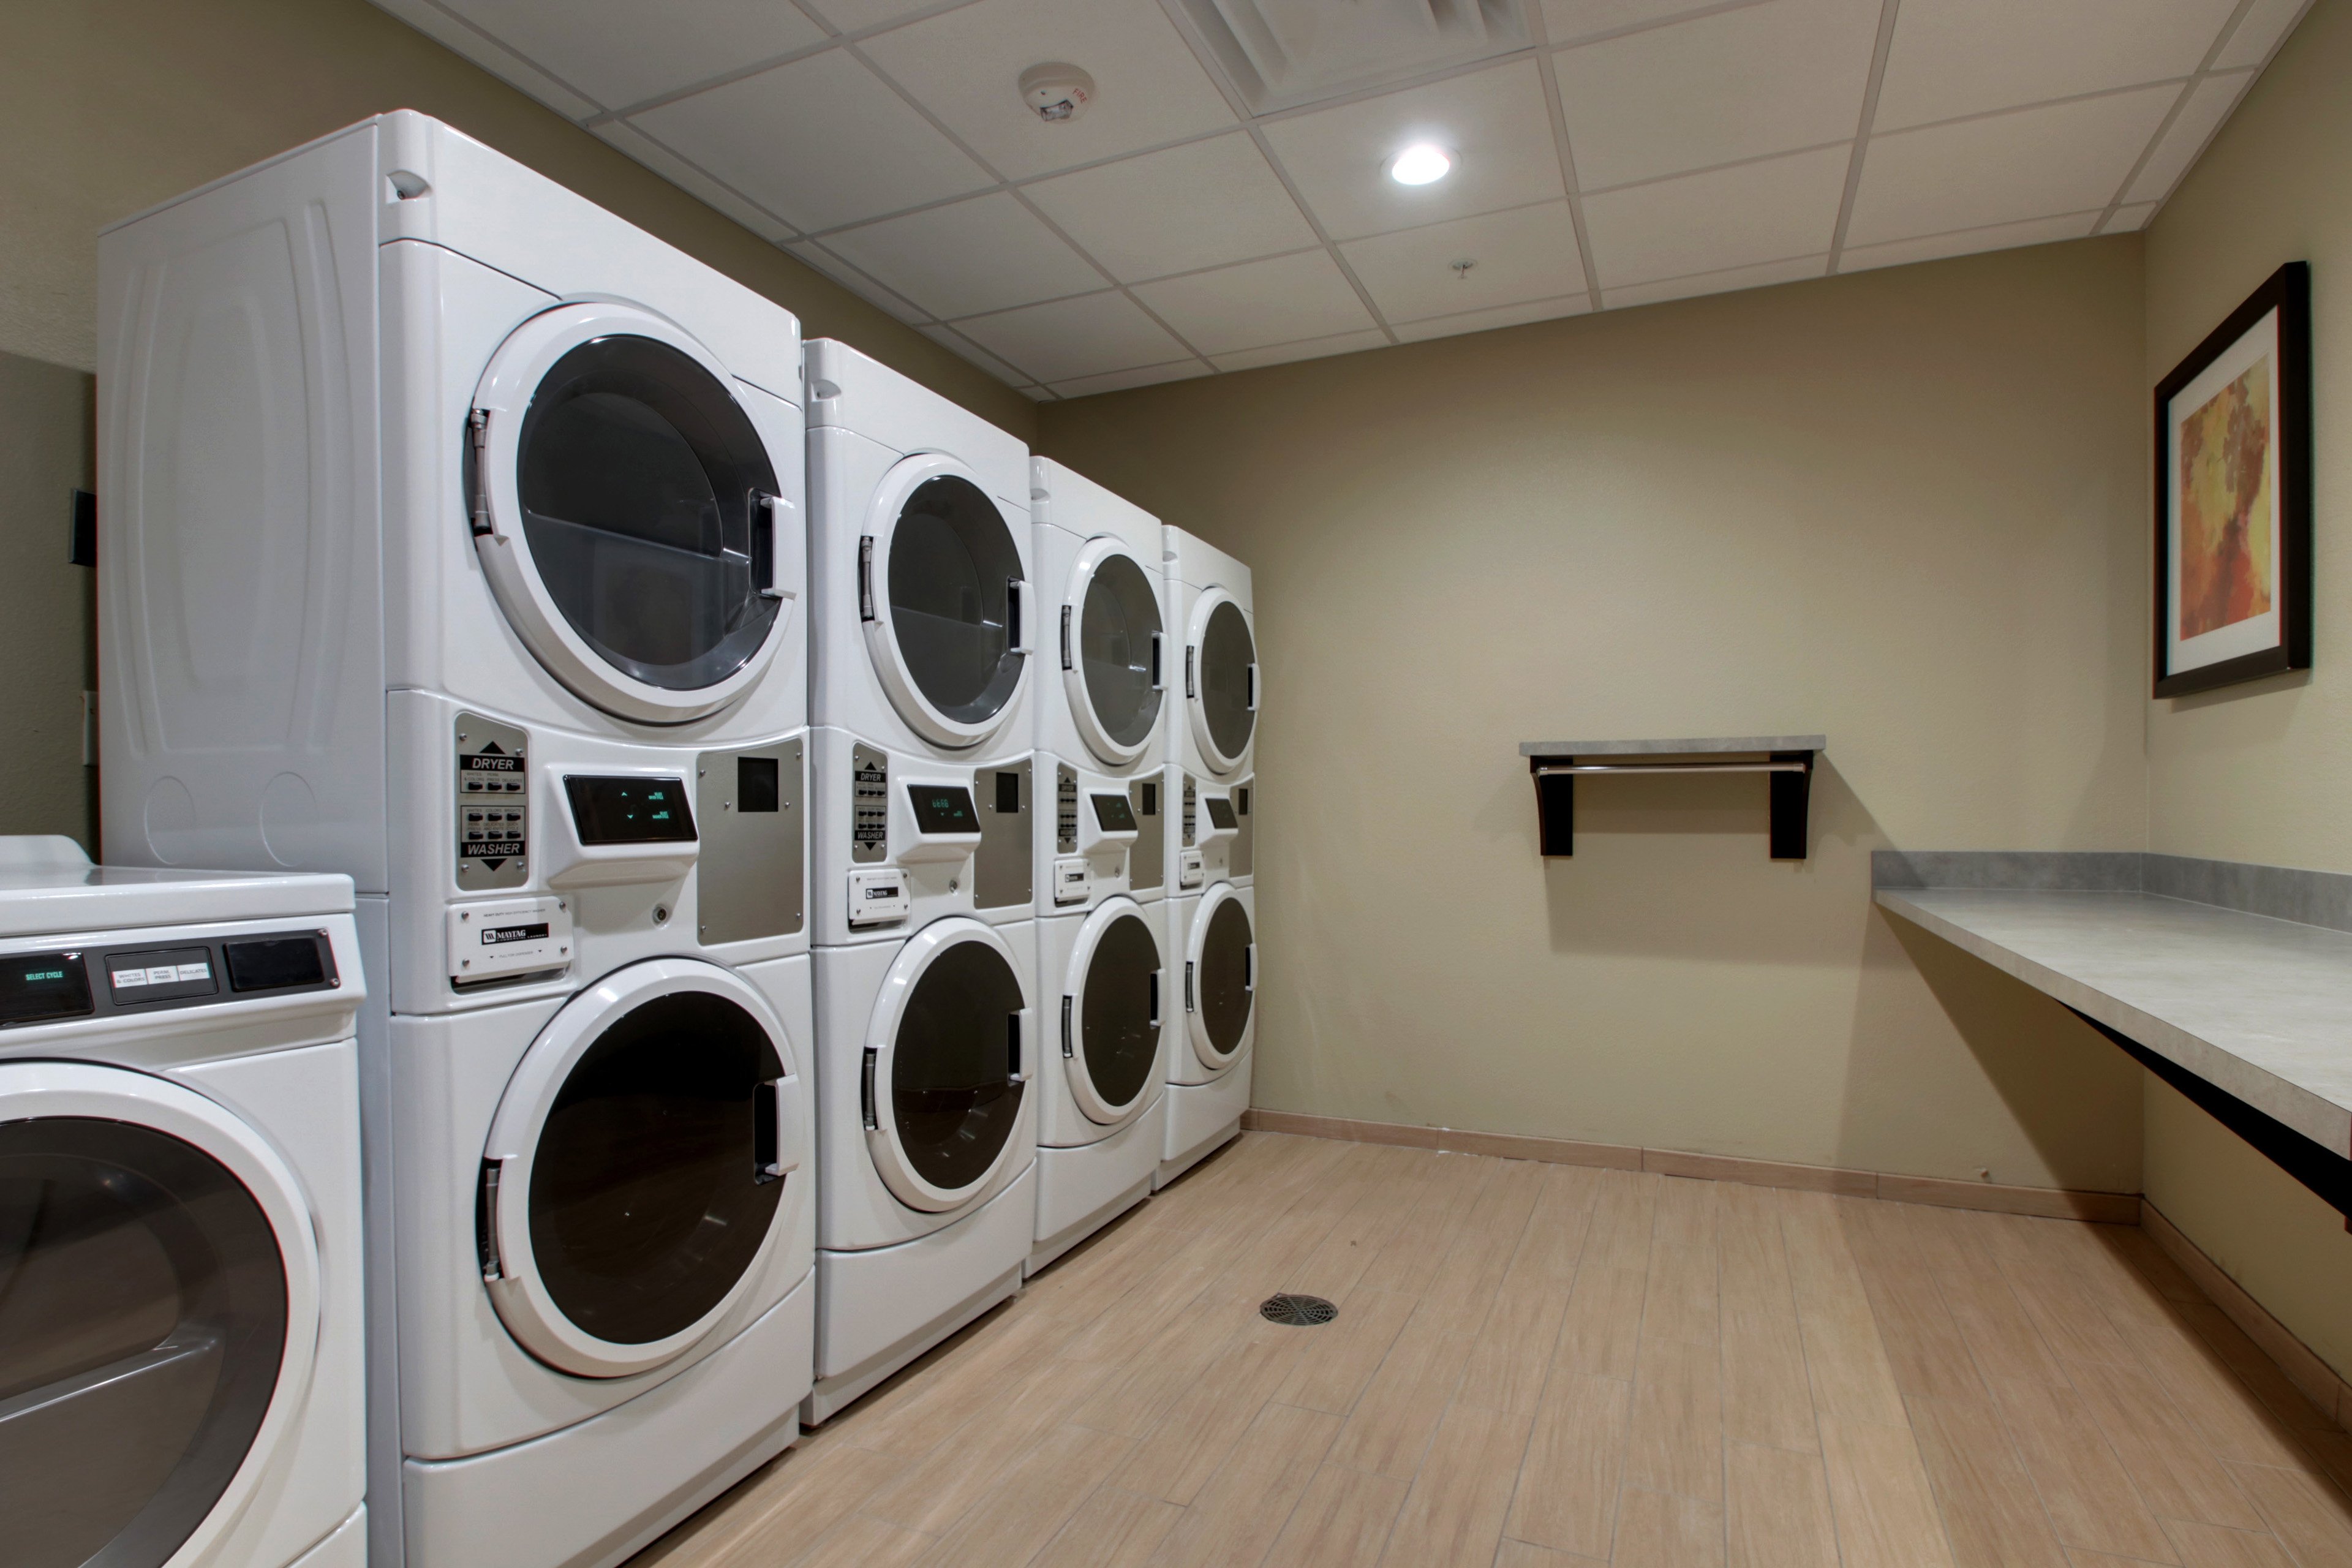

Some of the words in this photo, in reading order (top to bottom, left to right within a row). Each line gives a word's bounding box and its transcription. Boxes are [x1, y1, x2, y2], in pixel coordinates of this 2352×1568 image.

[1072, 88, 1087, 104] FIRE
[472, 758, 514, 770] DRYER
[861, 772, 881, 782] DRYER
[468, 843, 520, 855] WASHER
[497, 929, 526, 939] MAYTAG
